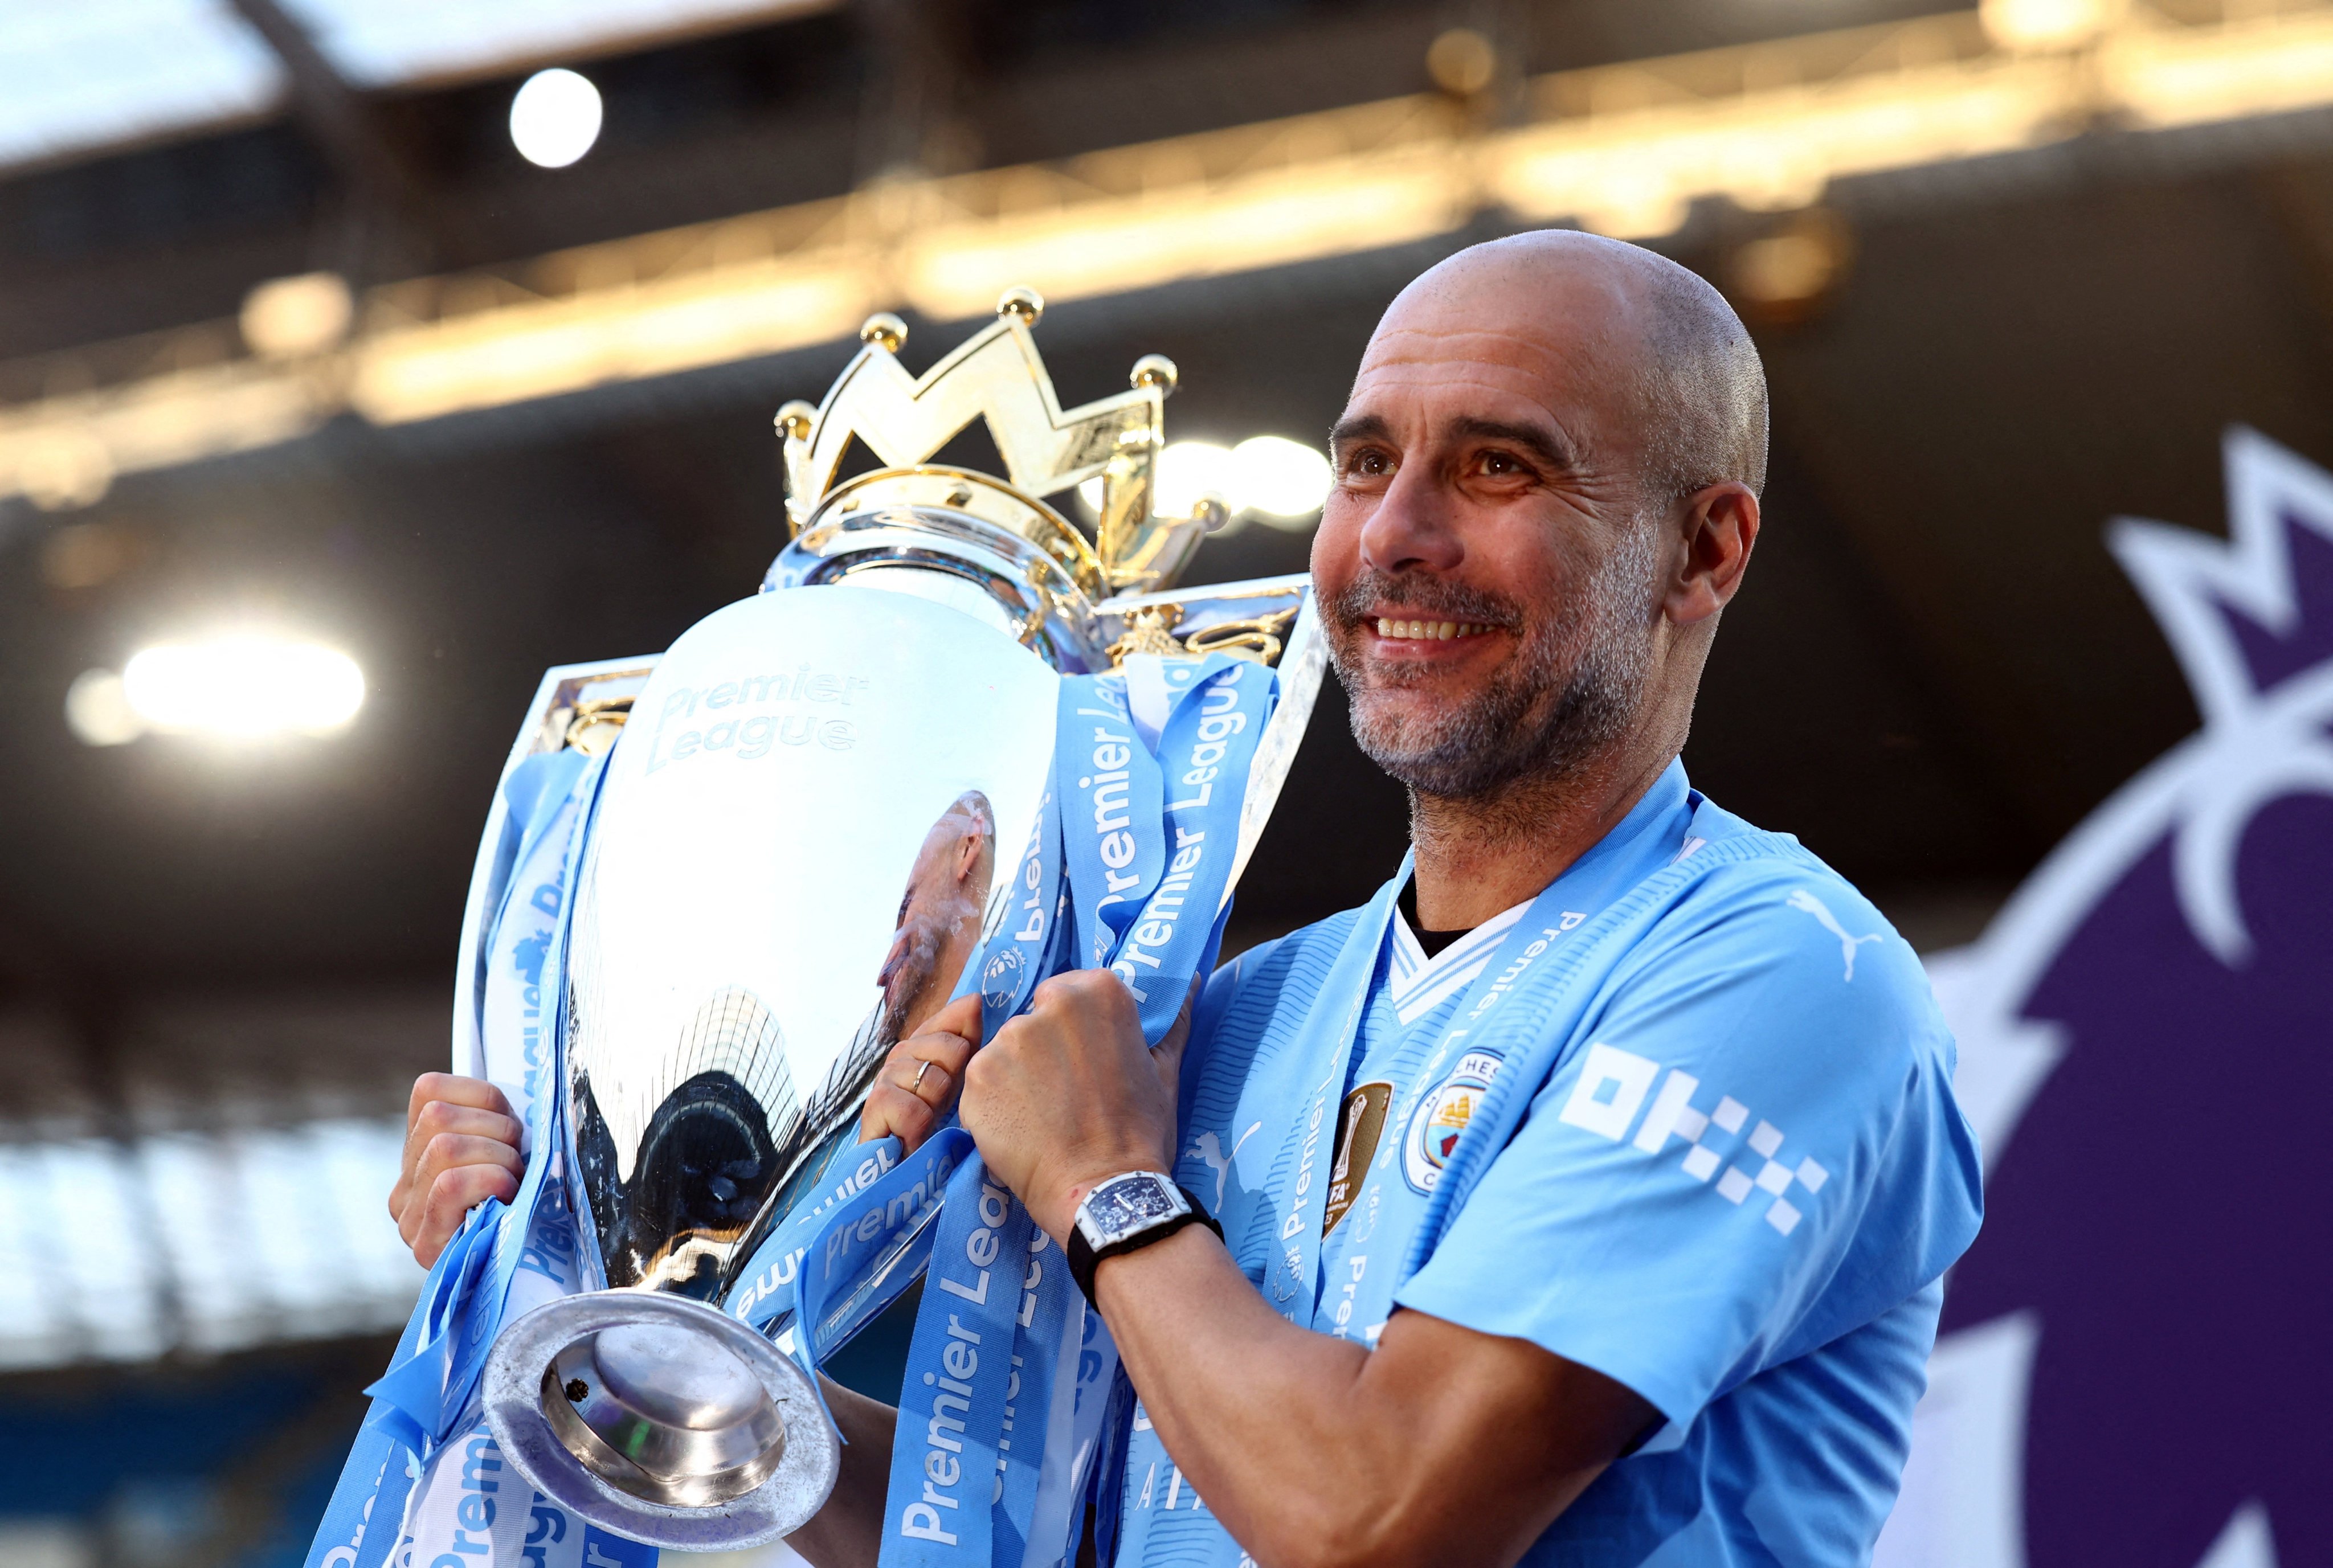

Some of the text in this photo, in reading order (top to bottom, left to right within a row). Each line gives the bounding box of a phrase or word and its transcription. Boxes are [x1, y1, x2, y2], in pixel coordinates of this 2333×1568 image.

[645, 715, 856, 777] League
[656, 662, 870, 733] Premier
[1162, 664, 1247, 813] League
[1378, 910, 1588, 1170] Premier League
[939, 1168, 1010, 1305] Lea
[1282, 1092, 1326, 1241] Premier
[901, 1313, 991, 1546] Premier
